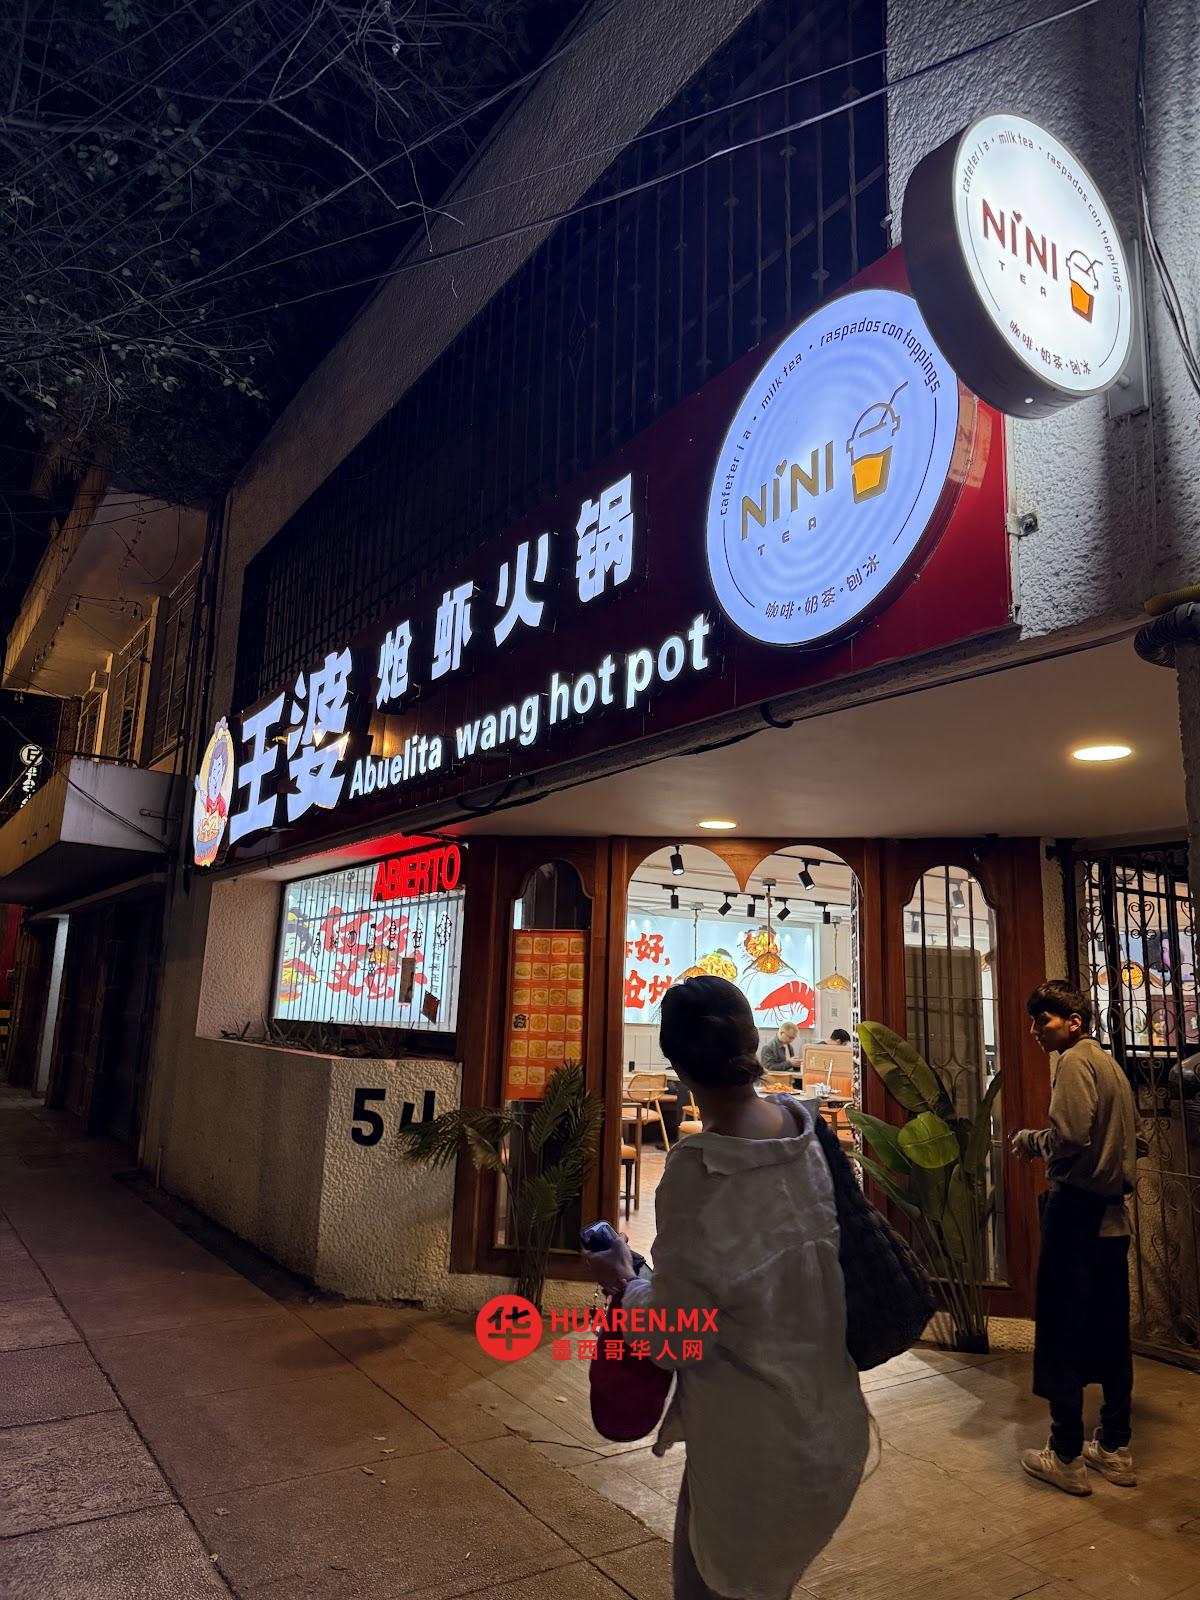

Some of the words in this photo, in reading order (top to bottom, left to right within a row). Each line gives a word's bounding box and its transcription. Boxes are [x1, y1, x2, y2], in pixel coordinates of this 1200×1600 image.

[998, 132, 1017, 146] milk
[1017, 134, 1034, 150] tea
[1047, 151, 1089, 203] raspados
[1087, 203, 1103, 228] con
[1100, 229, 1124, 293] toppings
[719, 430, 752, 517] cafeteria
[760, 376, 784, 410] milk
[782, 353, 803, 377] tea
[819, 316, 881, 348] raspados
[881, 320, 904, 340] con
[902, 329, 941, 394] toppings
[756, 516, 818, 557] TEA
[348, 734, 443, 800] Abuelita
[454, 694, 541, 760] wang
[550, 653, 616, 726] hot
[626, 612, 710, 710] pot
[372, 844, 462, 902] ABIERTO
